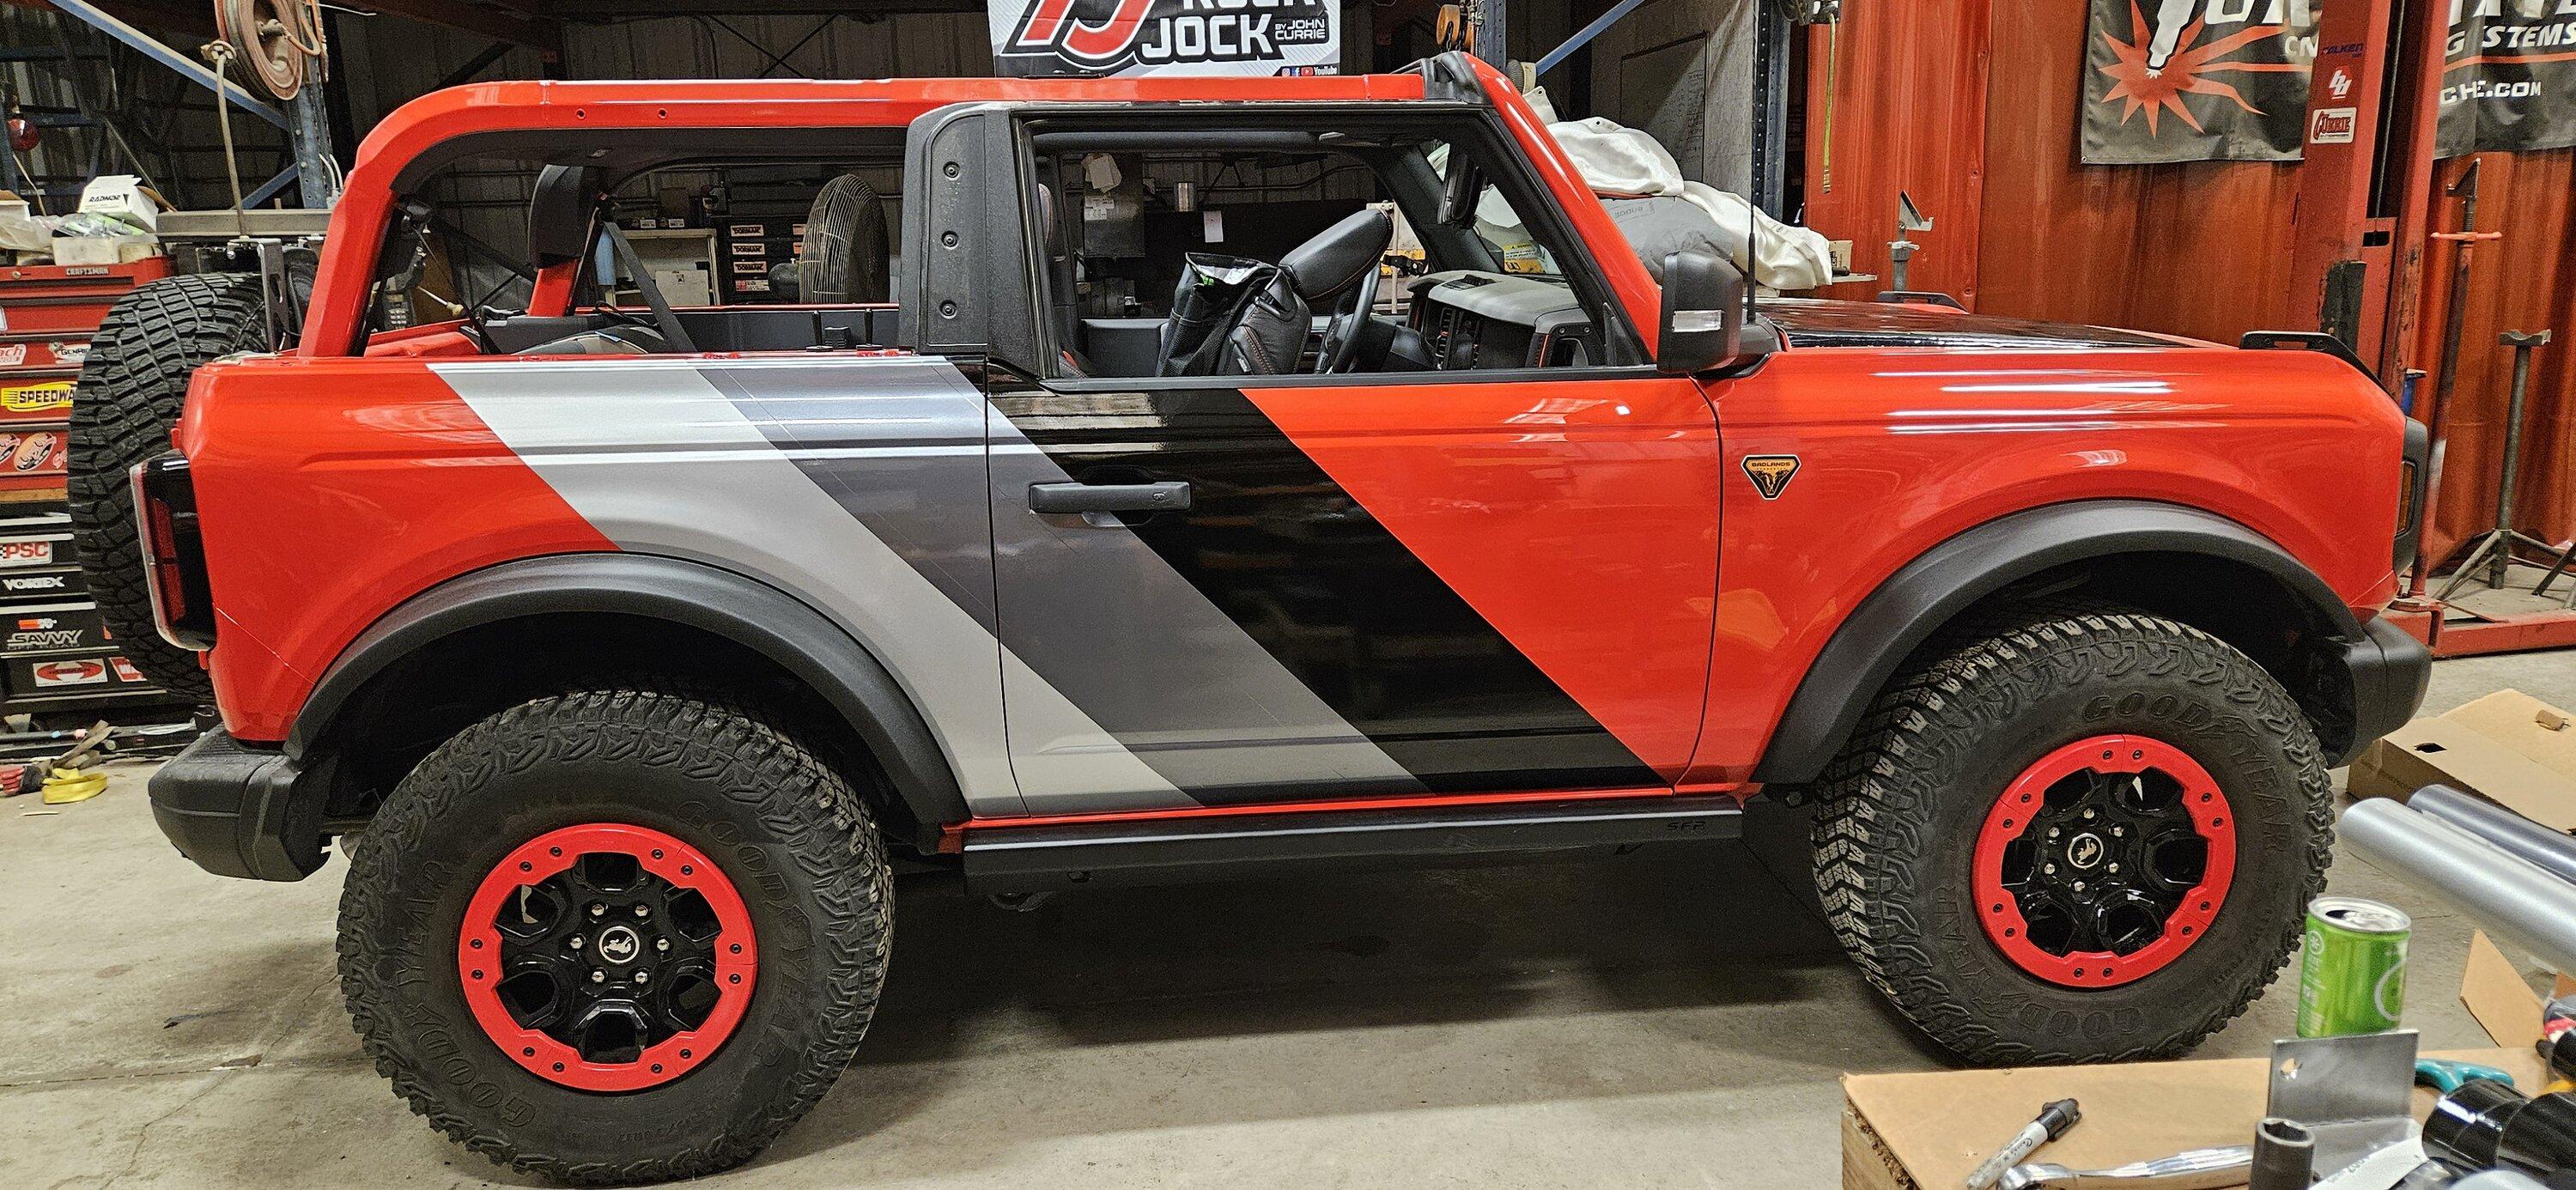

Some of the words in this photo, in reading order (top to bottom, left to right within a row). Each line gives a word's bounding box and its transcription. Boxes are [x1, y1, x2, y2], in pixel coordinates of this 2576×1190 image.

[1287, 19, 1325, 30] JOHN
[1142, 14, 1273, 58] JOCK
[1275, 29, 1325, 40] CURRIE
[1315, 66, 1338, 76] YouTube
[66, 267, 109, 276] CRAFTSMAN
[6, 542, 48, 559] PSC
[3, 576, 65, 591] VORTEX
[7, 629, 83, 646] SAVVY
